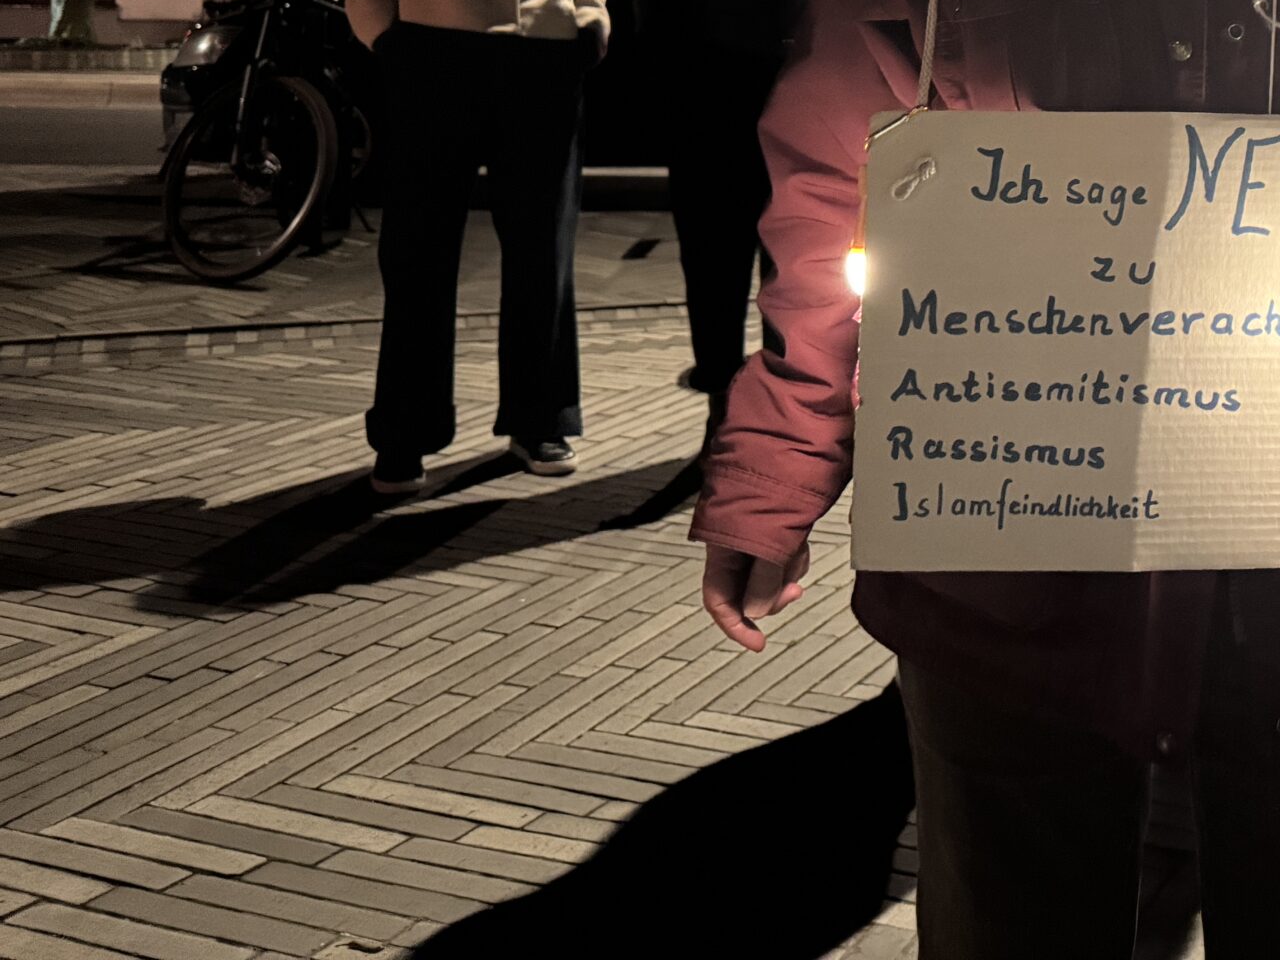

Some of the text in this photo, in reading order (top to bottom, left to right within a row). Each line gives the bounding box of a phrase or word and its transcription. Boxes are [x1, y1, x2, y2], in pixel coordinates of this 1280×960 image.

[970, 147, 1049, 205] Ich
[1066, 178, 1148, 226] sage
[1090, 256, 1156, 285] zu
[890, 368, 1242, 412] Antisemitismus
[886, 426, 1106, 470] Rassismus
[891, 479, 1161, 530] Islamfeindlichkeit
